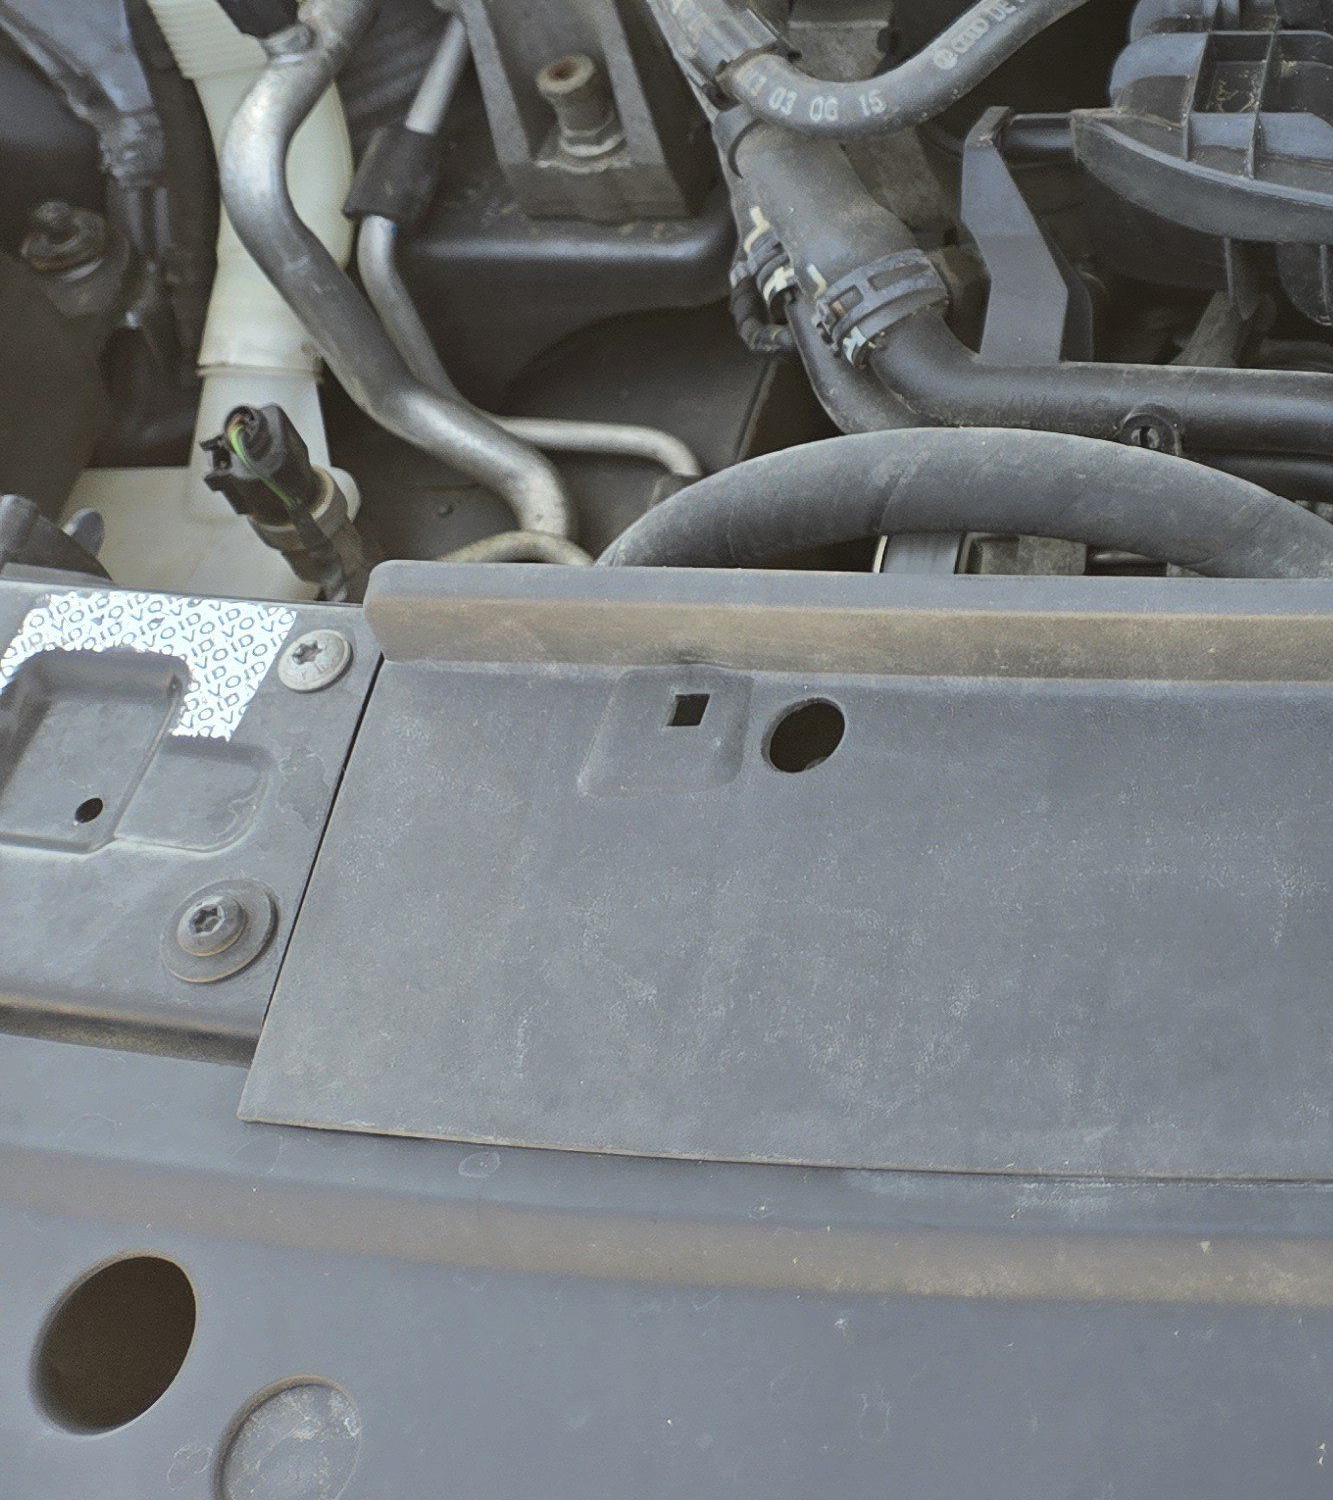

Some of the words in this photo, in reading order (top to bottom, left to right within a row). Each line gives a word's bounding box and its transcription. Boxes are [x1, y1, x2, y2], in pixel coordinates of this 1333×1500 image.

[809, 95, 839, 122] 06
[858, 89, 887, 117] 15
[143, 612, 201, 648] VOID
[182, 608, 241, 642] VOID
[194, 634, 254, 669] VOID
[208, 661, 266, 696] VOID
[180, 693, 240, 728] VOID
